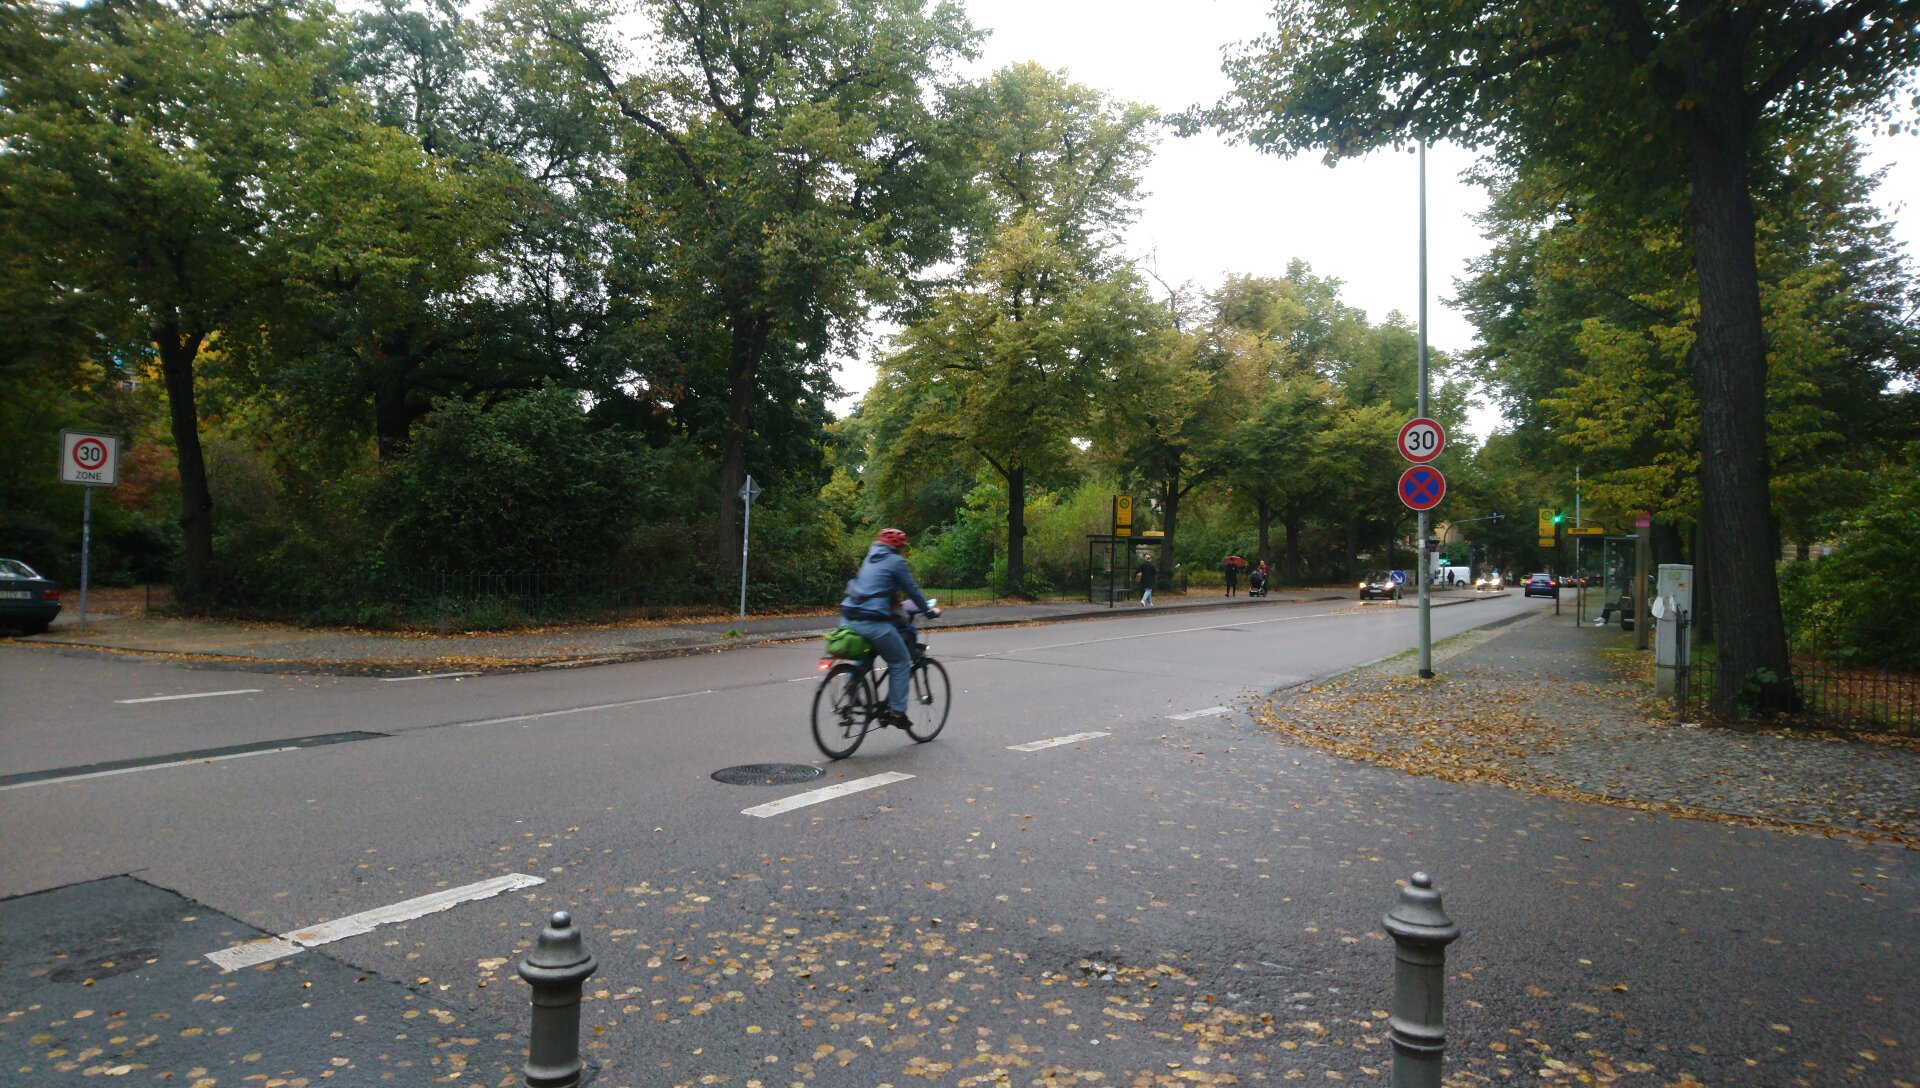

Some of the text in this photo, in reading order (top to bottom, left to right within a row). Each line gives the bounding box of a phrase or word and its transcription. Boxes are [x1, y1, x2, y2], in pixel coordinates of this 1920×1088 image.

[1408, 430, 1435, 451] 30
[80, 446, 100, 462] 30
[75, 470, 102, 481] ZONE
